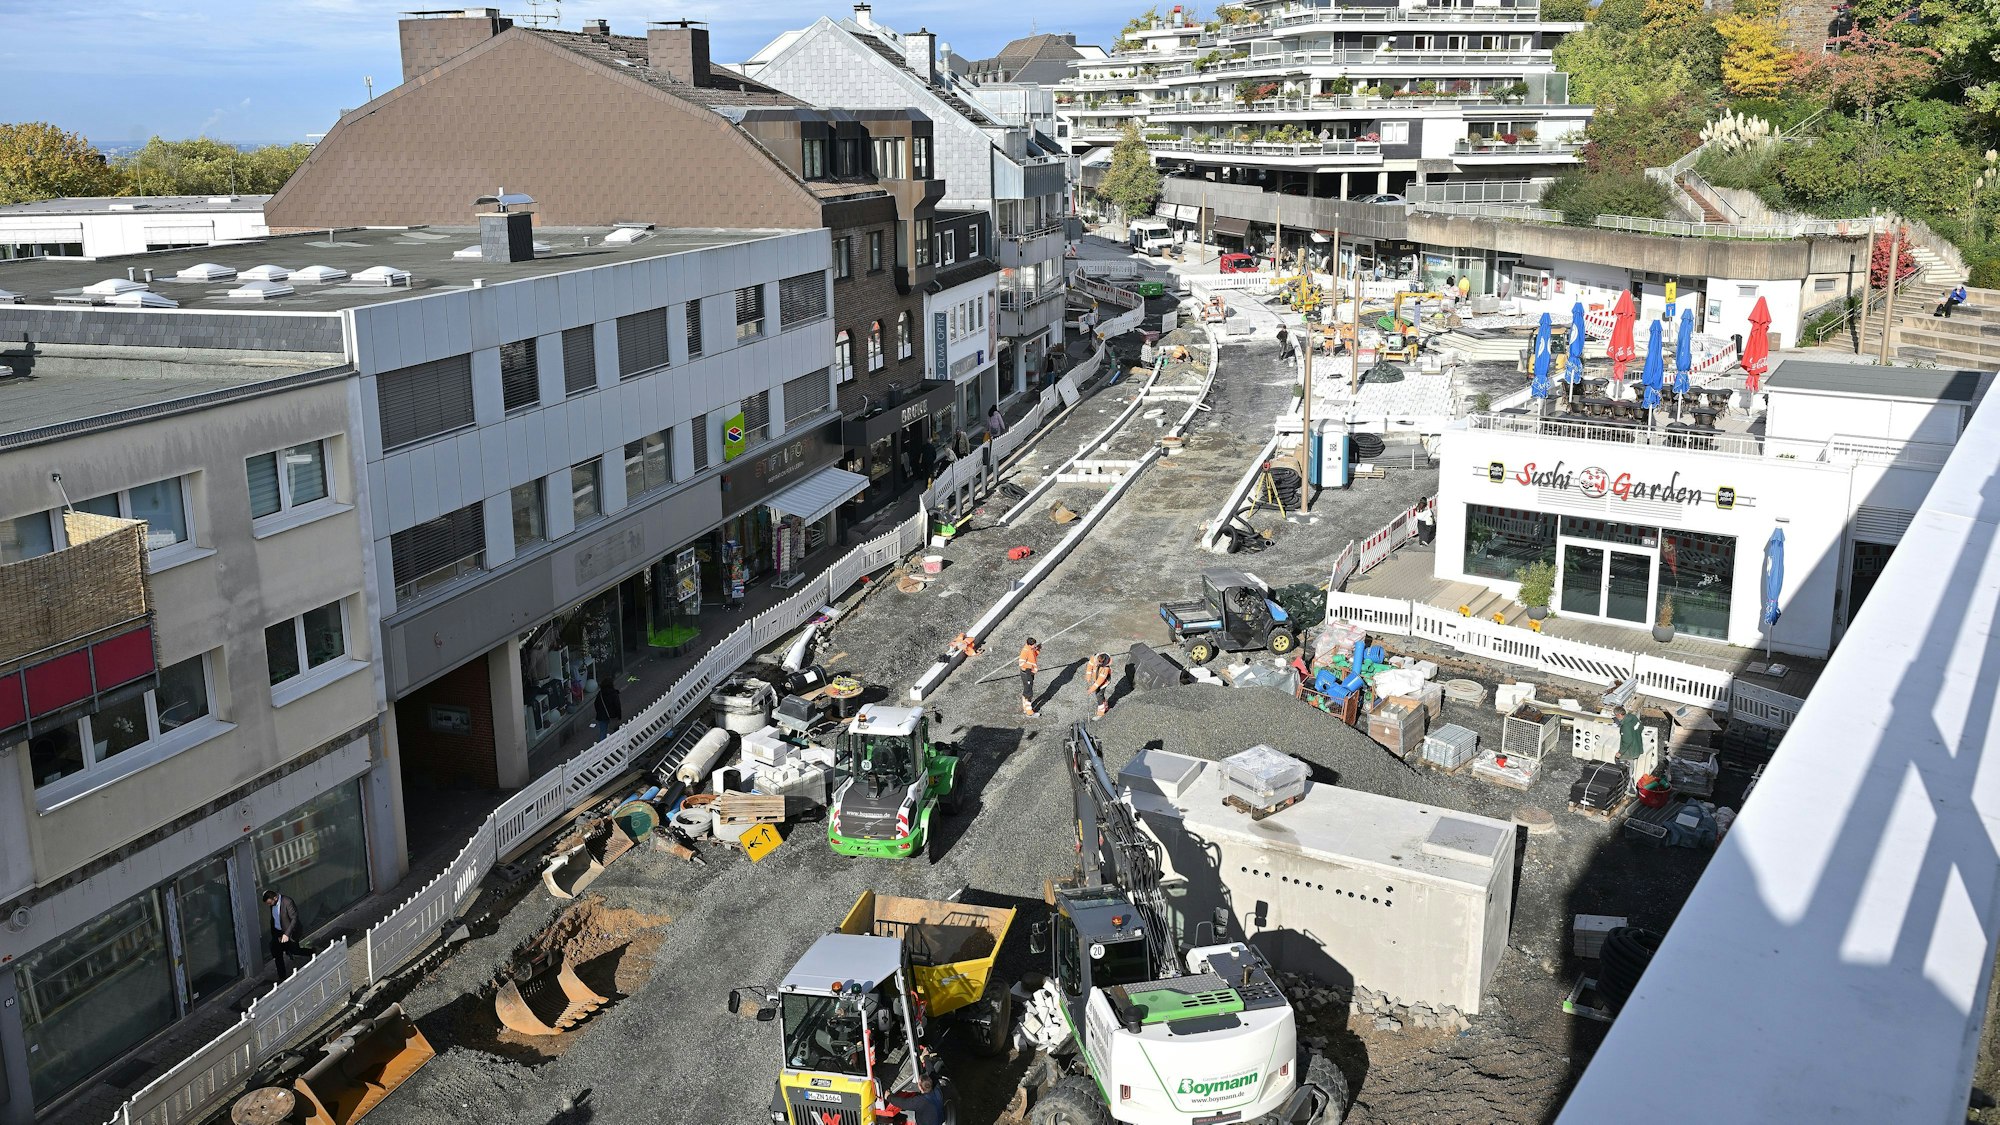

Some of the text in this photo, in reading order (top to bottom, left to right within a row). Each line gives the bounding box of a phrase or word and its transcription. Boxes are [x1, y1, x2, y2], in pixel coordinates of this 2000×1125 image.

[937, 314, 945, 340] OPTIK
[938, 342, 946, 368] OLMA
[1516, 461, 1702, 506] Sushi Garden
[1093, 946, 1102, 956] 20
[1178, 1072, 1258, 1096] Boymann
[1192, 1090, 1244, 1104] www.boymann.de
